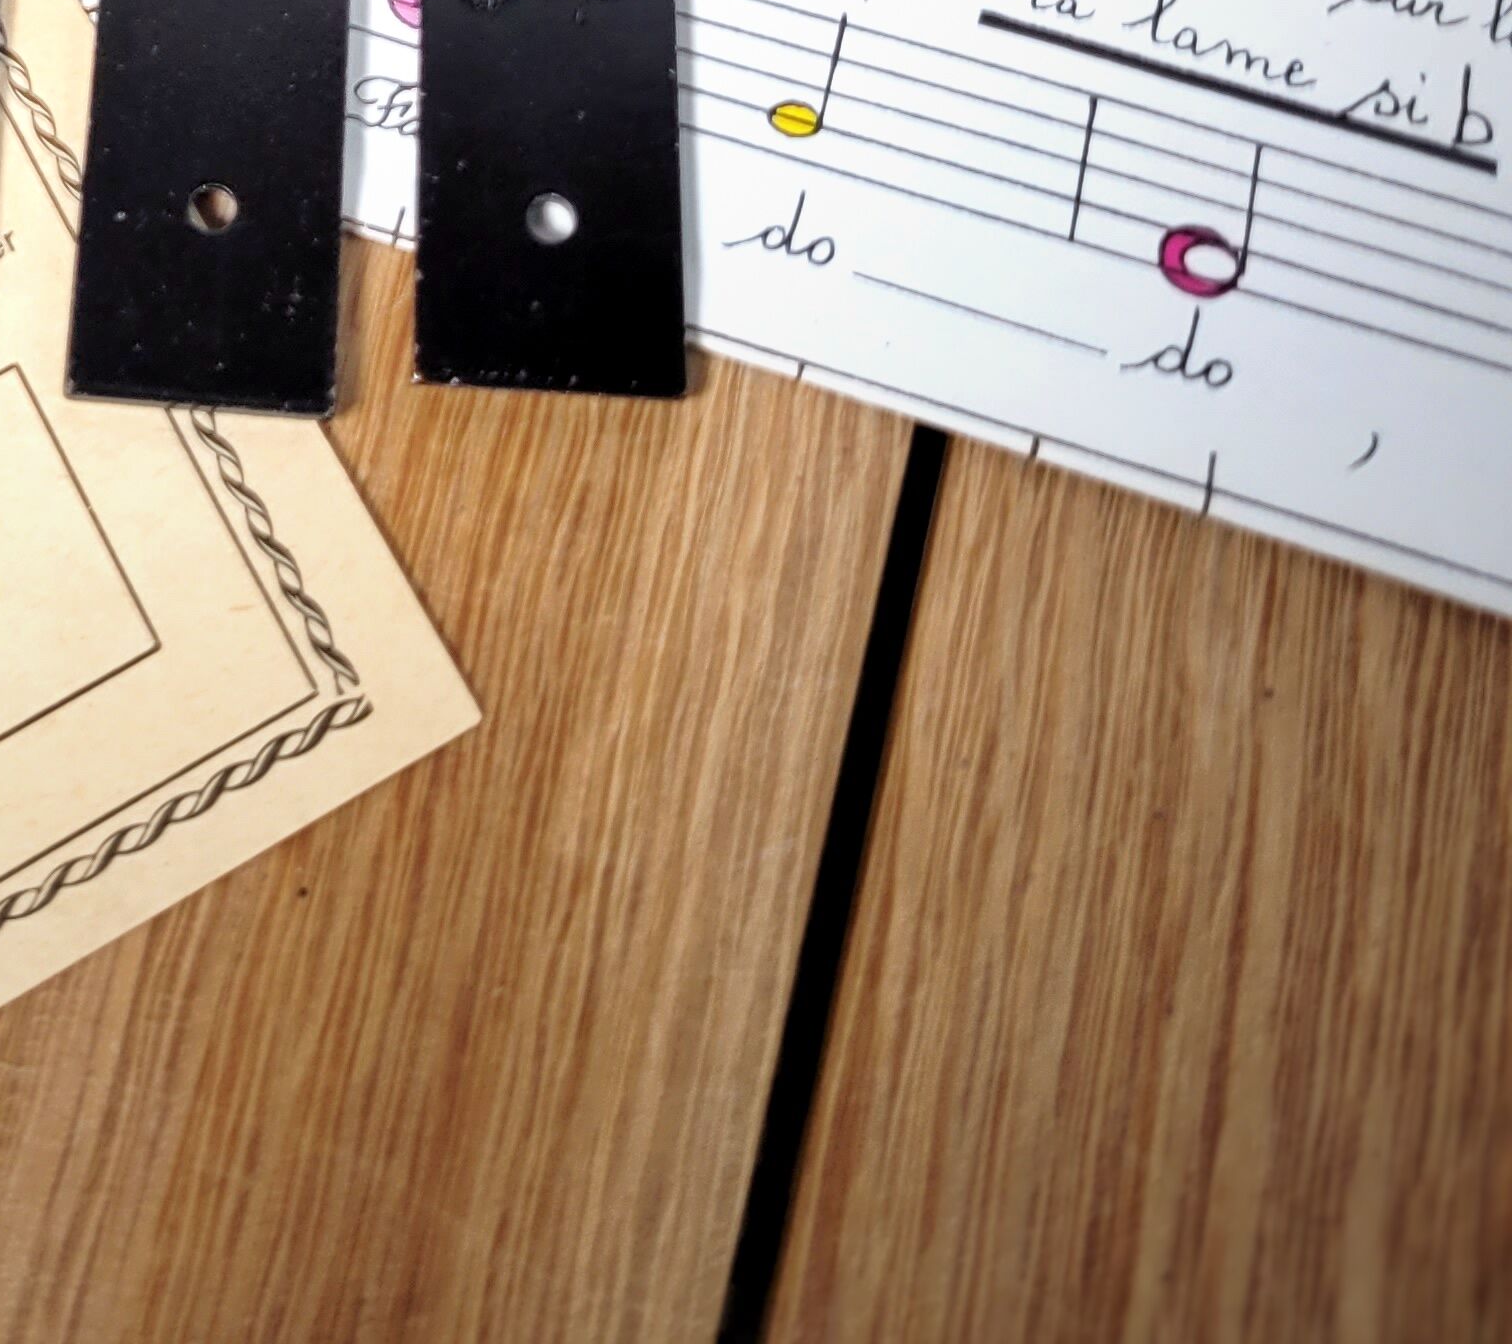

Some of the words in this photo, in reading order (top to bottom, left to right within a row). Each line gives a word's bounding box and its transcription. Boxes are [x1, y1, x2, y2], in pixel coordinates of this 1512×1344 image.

[1337, 66, 1428, 126] si
[722, 190, 837, 268] do
[1120, 306, 1236, 389] do
